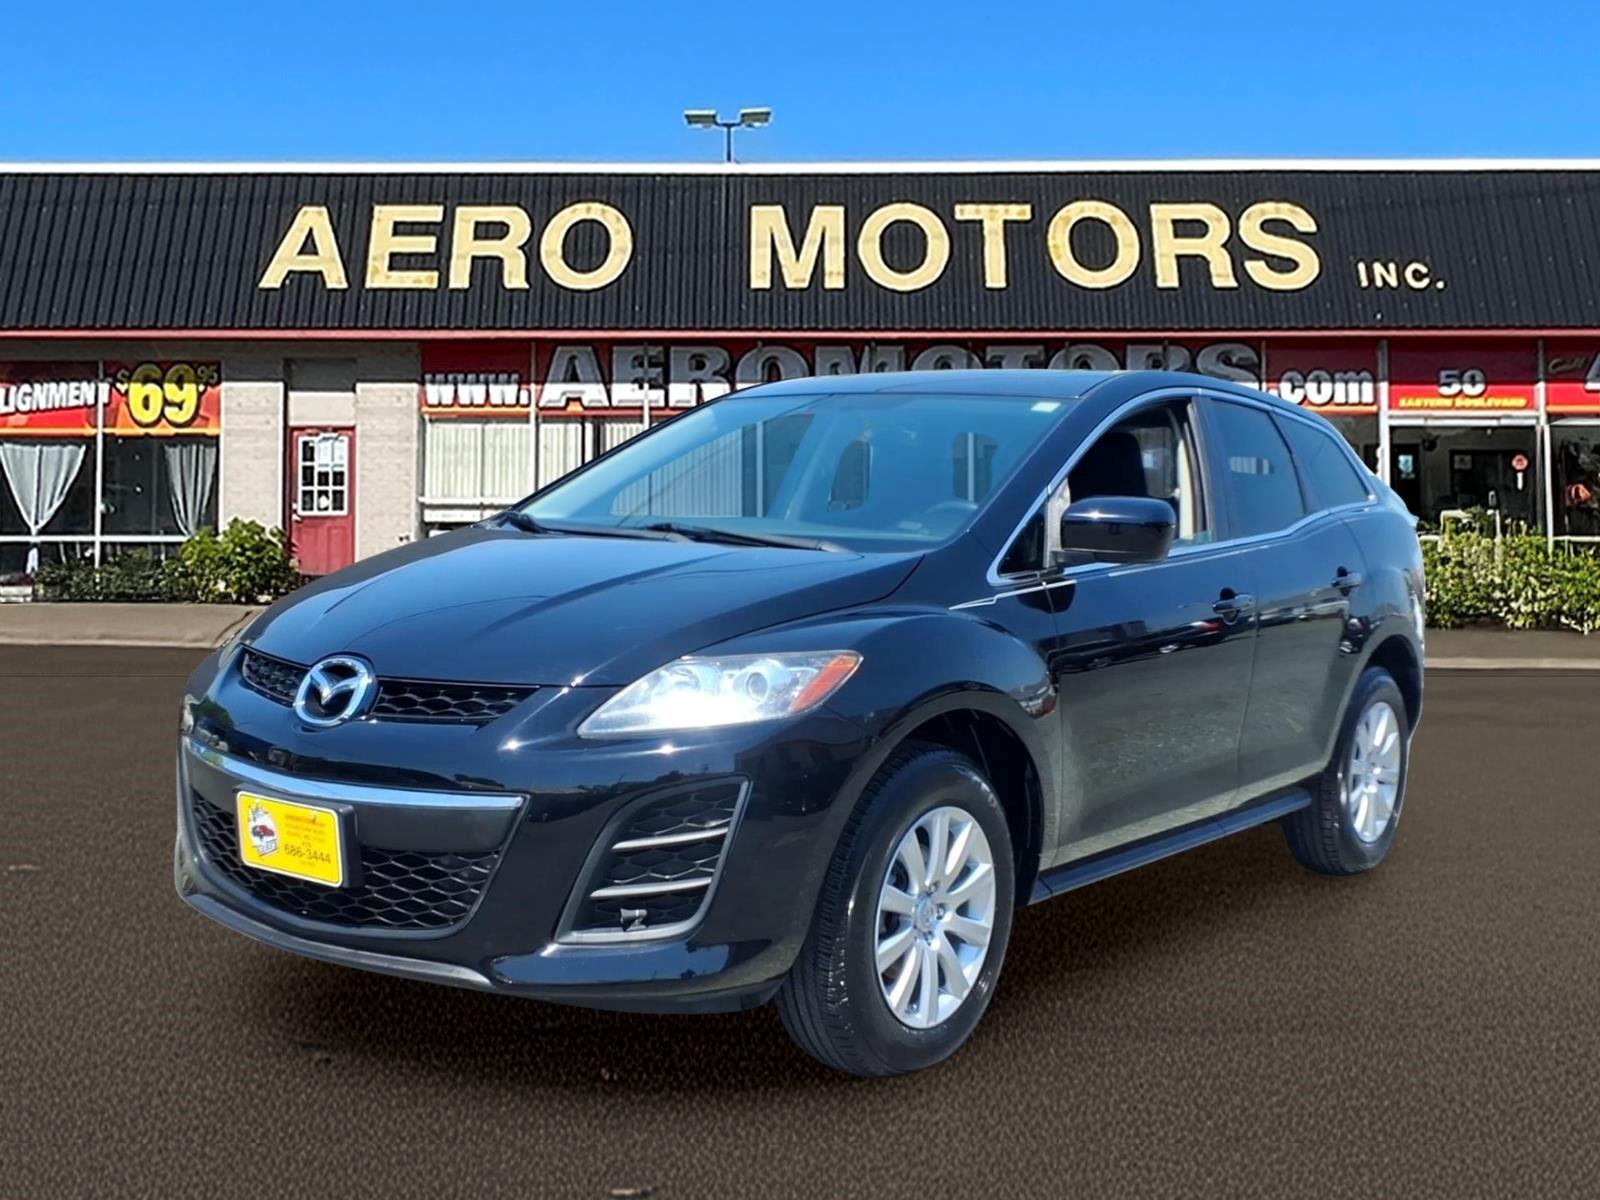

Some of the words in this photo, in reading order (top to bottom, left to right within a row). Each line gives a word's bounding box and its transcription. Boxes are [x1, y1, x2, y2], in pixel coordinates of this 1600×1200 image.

[257, 202, 634, 290] AERO
[749, 199, 1321, 291] MOTORS
[1357, 261, 1447, 289] INC.
[1438, 368, 1486, 396] 50
